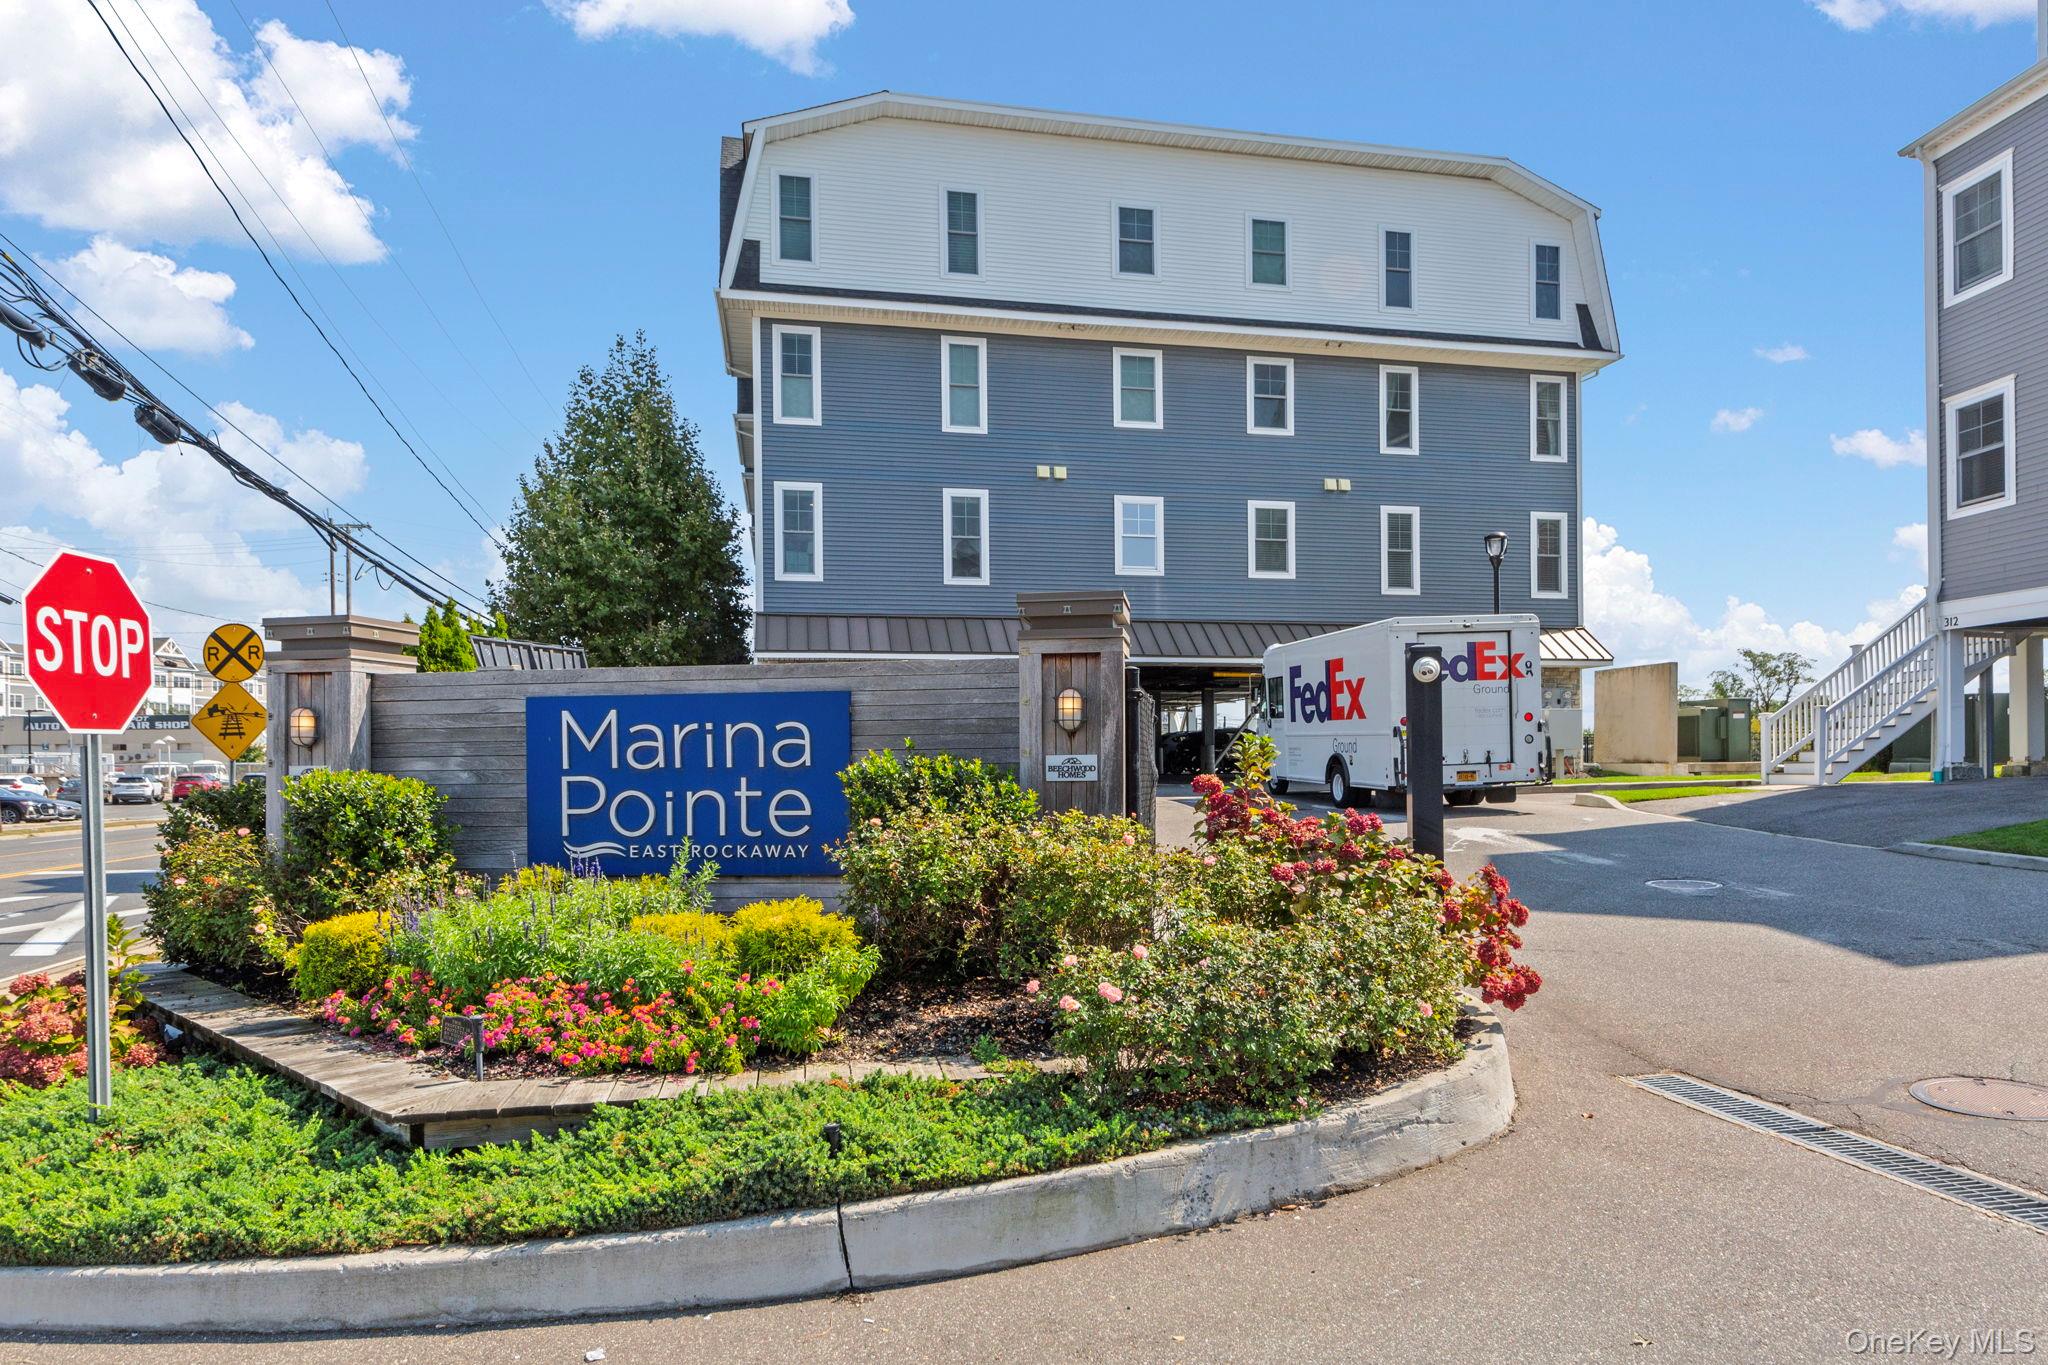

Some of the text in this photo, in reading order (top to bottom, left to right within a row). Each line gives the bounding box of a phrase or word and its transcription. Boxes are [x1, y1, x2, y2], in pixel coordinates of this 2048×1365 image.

[1944, 616, 1959, 627] 312
[35, 605, 145, 679] STOP
[207, 645, 260, 661] R R
[1289, 657, 1367, 723] FedEx
[1473, 684, 1511, 694] Ground
[25, 721, 189, 730] AUTO AIR SHOP
[561, 709, 812, 770] Marina
[1333, 737, 1357, 753] Ground
[561, 775, 812, 838] Pointe
[629, 844, 809, 858] EAST ROCKAWAY
